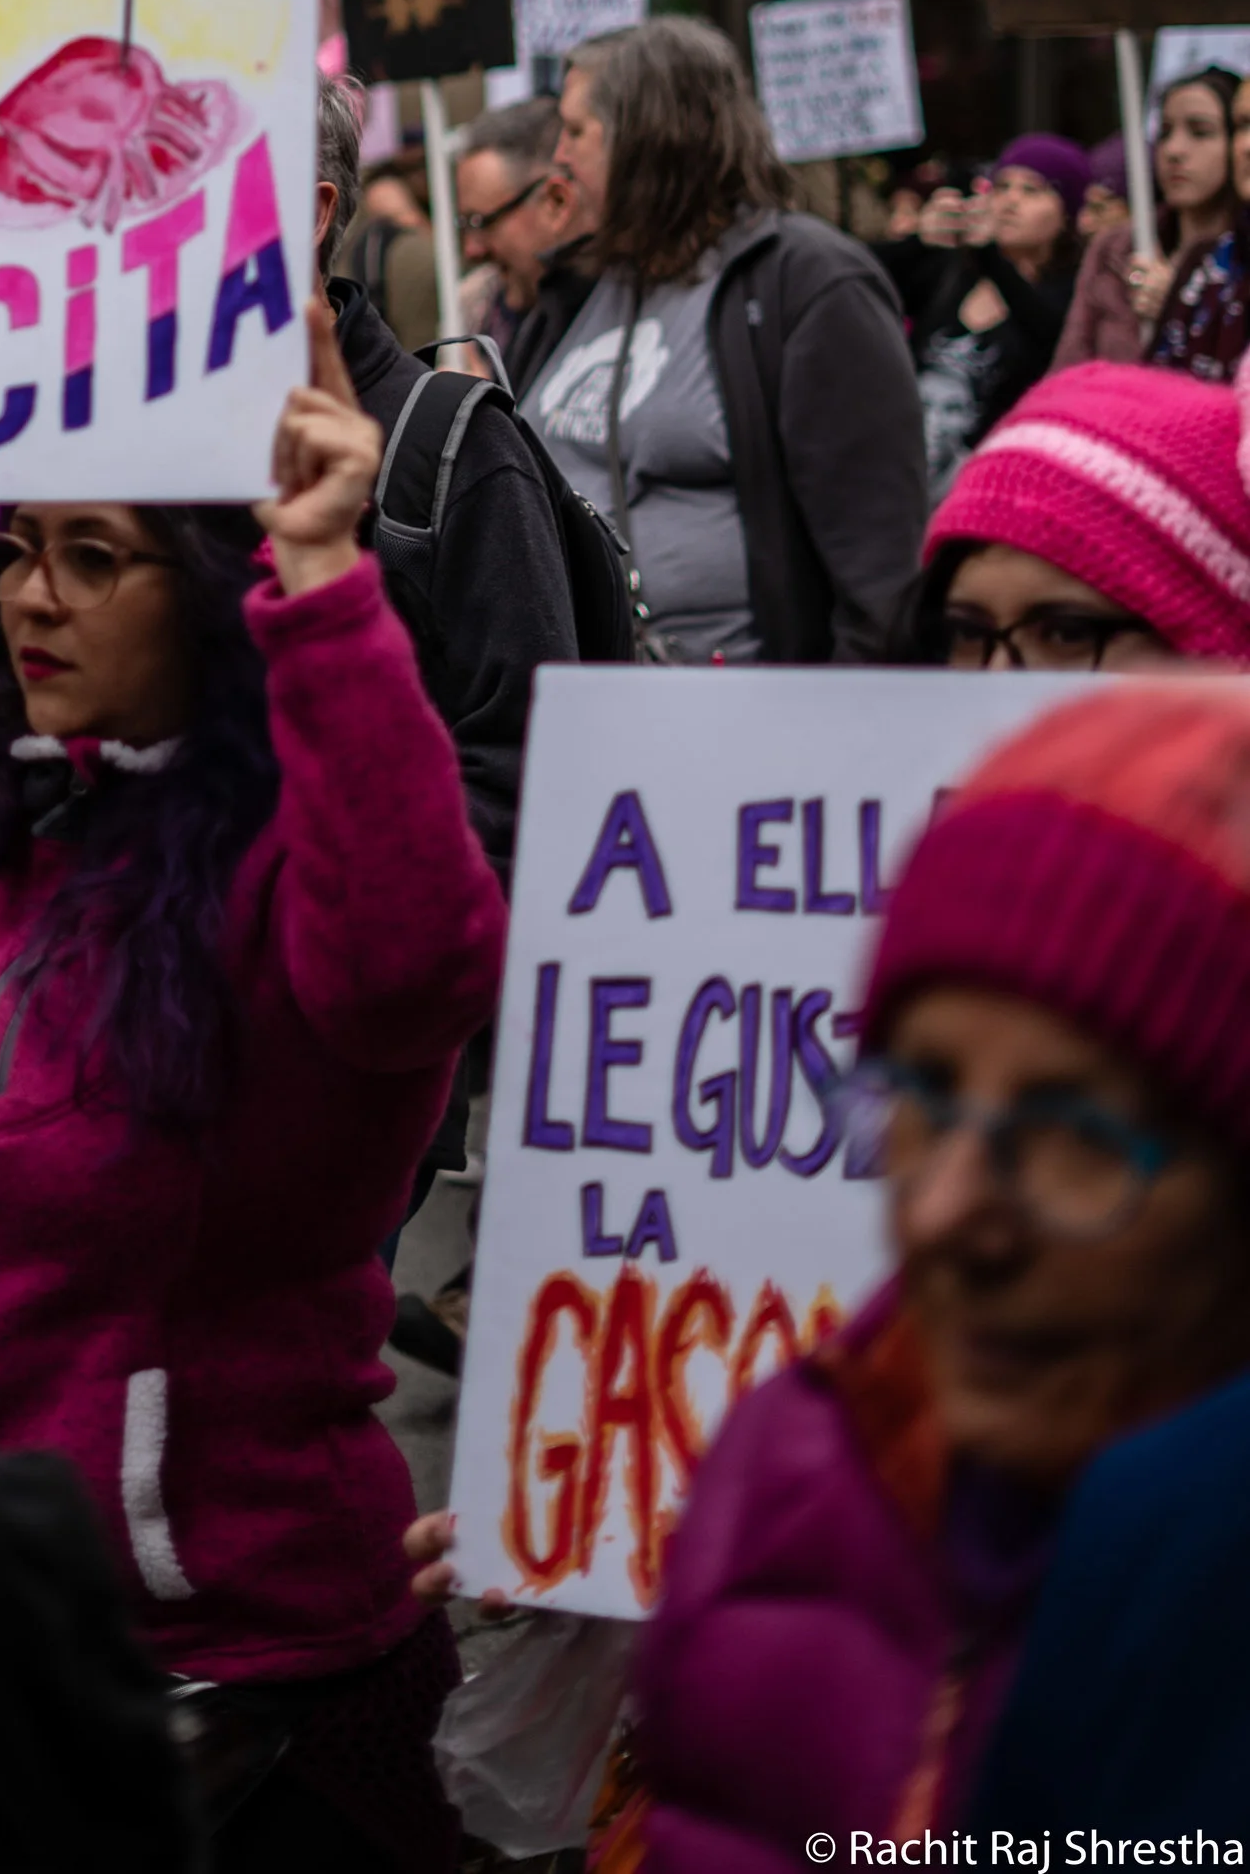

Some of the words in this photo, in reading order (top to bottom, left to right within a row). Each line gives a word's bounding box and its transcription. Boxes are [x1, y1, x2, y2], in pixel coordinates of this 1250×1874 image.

[567, 789, 673, 919] A
[734, 787, 940, 917] ELL
[522, 960, 653, 1154] LE
[580, 1181, 678, 1262] LA
